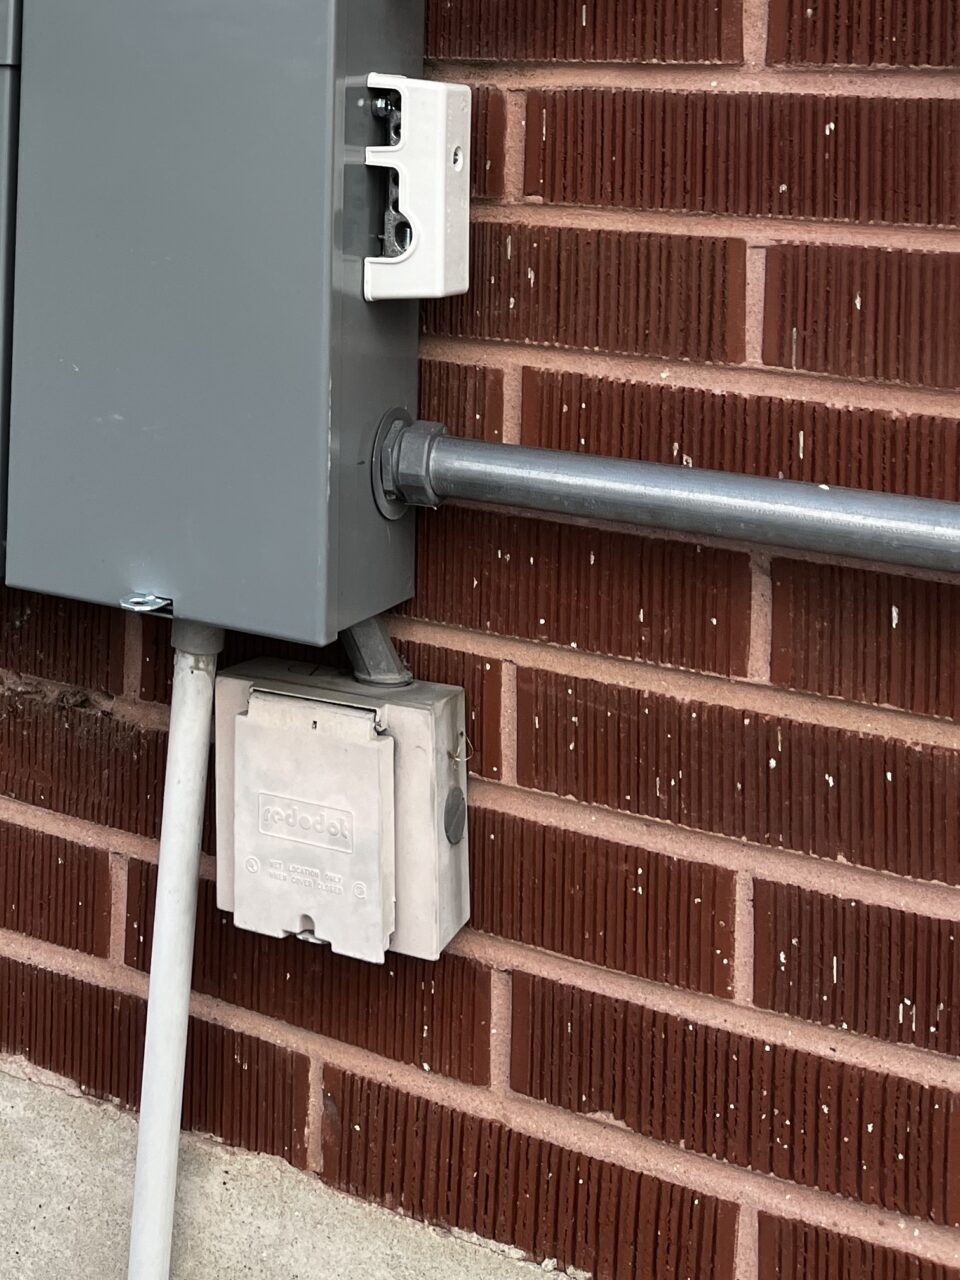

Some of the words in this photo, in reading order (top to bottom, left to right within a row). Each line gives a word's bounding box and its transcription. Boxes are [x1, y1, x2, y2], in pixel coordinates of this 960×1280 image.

[288, 864, 320, 879] LOCATION
[325, 871, 343, 883] ONLY
[291, 876, 313, 888] COVER
[317, 881, 344, 895] CLOSED
